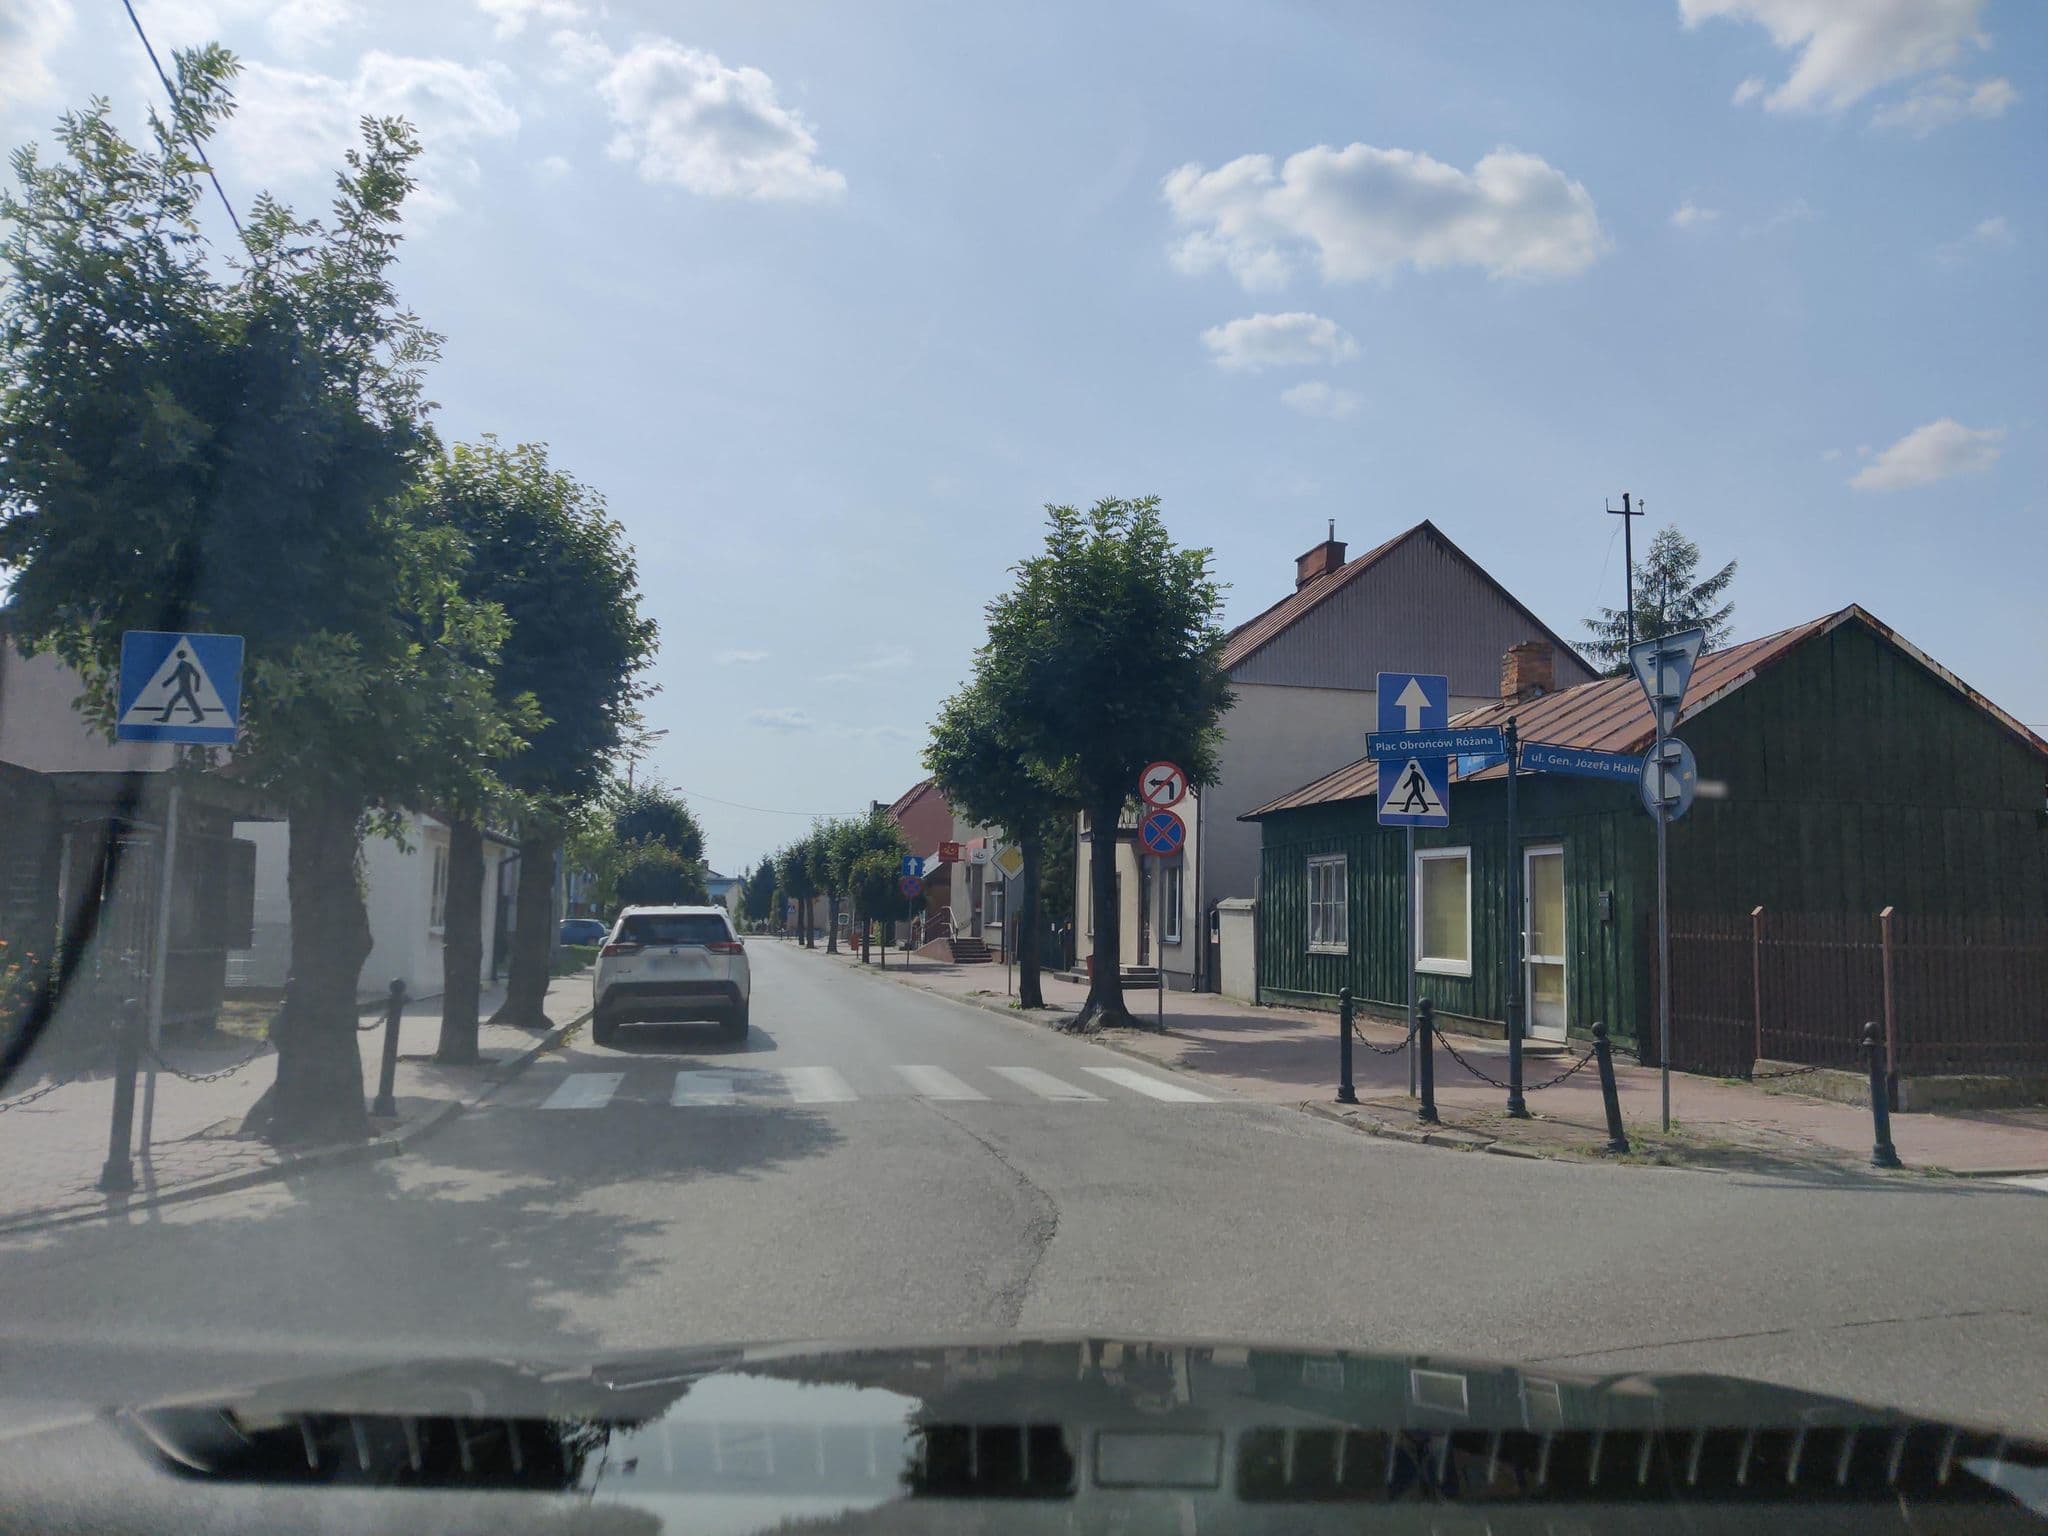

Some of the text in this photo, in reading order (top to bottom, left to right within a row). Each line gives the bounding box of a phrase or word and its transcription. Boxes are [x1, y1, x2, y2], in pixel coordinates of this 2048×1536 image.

[1375, 736, 1494, 752] Plac Obrońców Różana
[1531, 753, 1641, 775] ul. Gen. Józefa Halle
